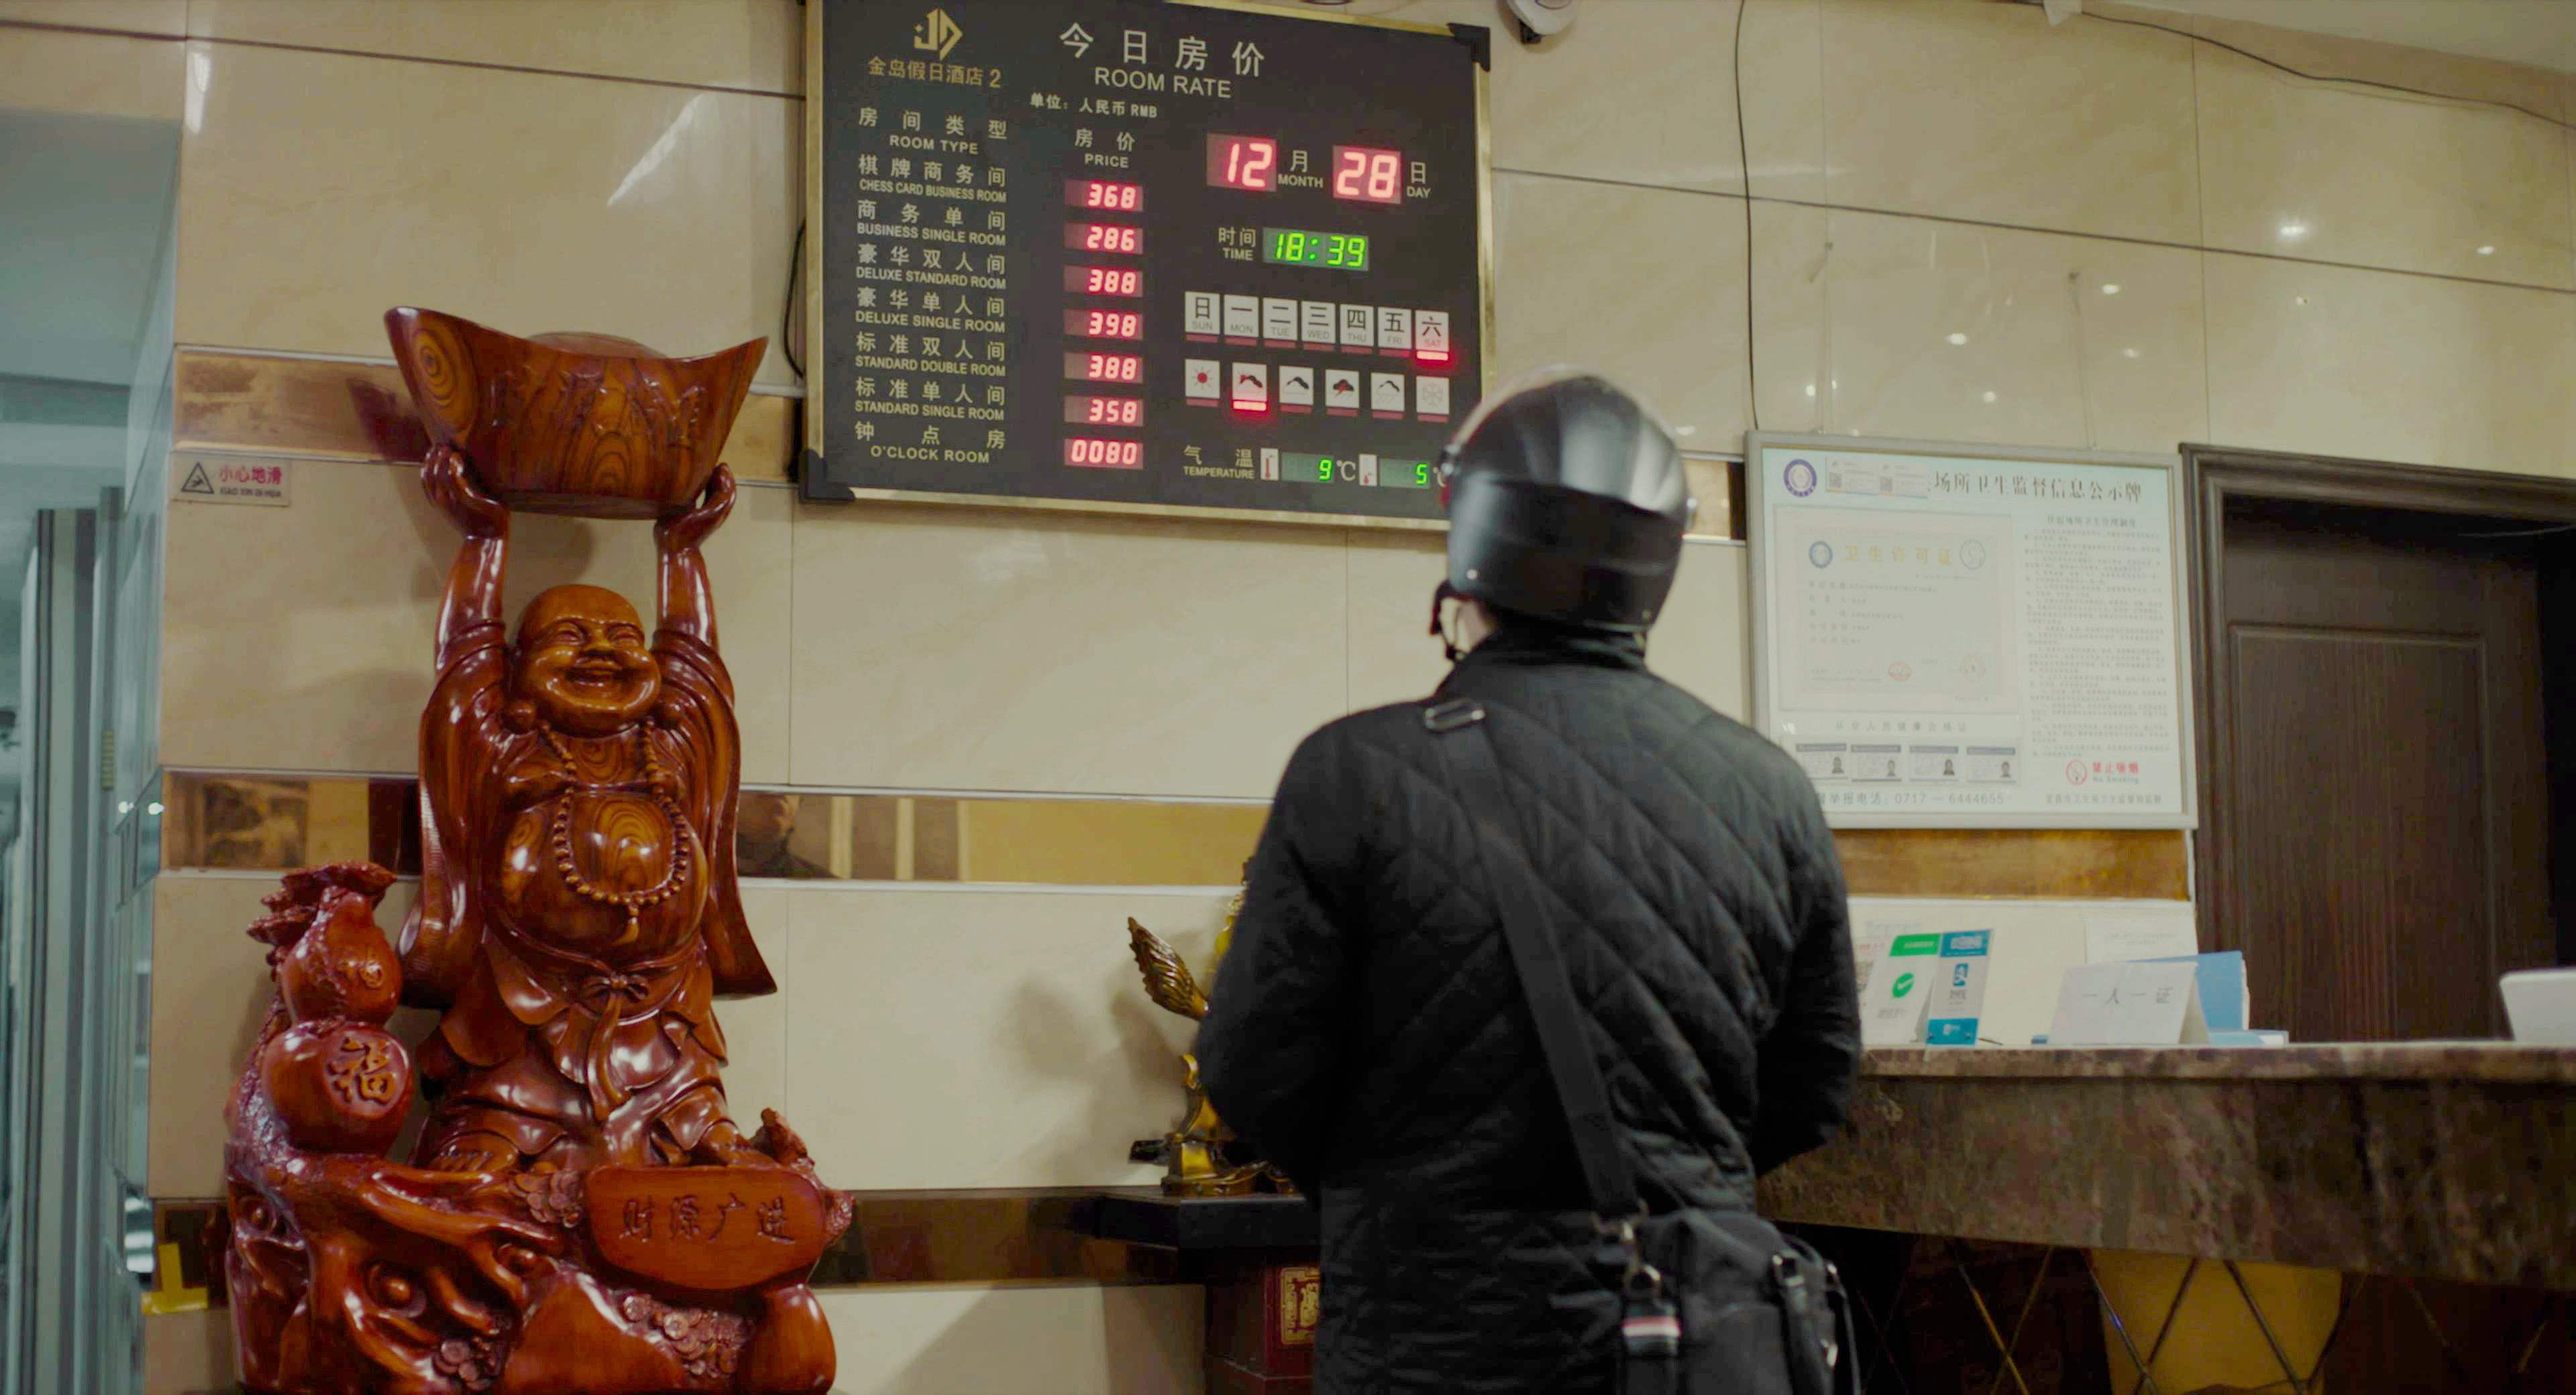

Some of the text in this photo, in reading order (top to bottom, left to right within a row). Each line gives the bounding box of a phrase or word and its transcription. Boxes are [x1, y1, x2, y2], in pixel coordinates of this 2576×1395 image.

[1059, 22, 1265, 77] 今日房价
[868, 56, 1002, 88] 金岛假日酒店 2
[1095, 66, 1232, 99] ROOM RATE
[1079, 98, 1126, 116] 人民币
[1130, 103, 1158, 118] RMB
[859, 107, 1007, 140] 房间类型
[890, 134, 978, 155] ROOM TYPE
[1075, 128, 1136, 152] 房价
[859, 154, 1006, 188] 棋牌商务间
[1085, 154, 1129, 168] PRICE
[1227, 142, 1273, 188] 12
[1290, 150, 1307, 172] 月
[1411, 161, 1426, 184] 日
[1278, 173, 1324, 188] MONTH
[1336, 151, 1398, 199] 28
[859, 178, 1007, 203] CHESS CARD BUSINESS ROOM
[1087, 183, 1136, 209] 368
[1406, 186, 1431, 199] DAY
[857, 199, 1006, 231] 商务单间
[857, 222, 1006, 246] BUSINESS SINGLE ROOM
[1087, 225, 1135, 252] 286
[1218, 227, 1256, 247] 时间
[857, 243, 1005, 275] 豪华双人间
[1222, 247, 1254, 262] TIME
[1275, 232, 1366, 268] 18:39
[856, 266, 1006, 290] DELUXE STANDARD ROOM
[1088, 268, 1136, 294] 388
[857, 286, 1004, 317] 豪华单人间
[1195, 297, 1210, 319] 日
[855, 311, 1005, 333] DELUXE SINGLE ROOM
[1089, 311, 1137, 337] 398
[1192, 321, 1213, 330] SUN
[1270, 305, 1291, 324] 二
[1307, 305, 1330, 327] 三
[1347, 309, 1366, 330] 四
[1384, 312, 1405, 333] 五
[1421, 316, 1442, 337] 六
[1230, 325, 1253, 333] MON
[1271, 327, 1291, 336] TUE
[1307, 329, 1330, 339] WED
[1348, 333, 1366, 343] THU
[1387, 336, 1403, 345] FRI
[856, 331, 1005, 362] 标准双人间
[1425, 339, 1442, 347] SAT
[855, 355, 1006, 377] STANDARD DOUBLE ROOM
[1089, 354, 1137, 380] 388
[855, 376, 1005, 406] 标准单人间
[855, 400, 1004, 421] STANDARD SINGLE ROOM
[1089, 398, 1138, 424] 358
[855, 421, 1006, 449] 钟点房
[870, 445, 989, 463] O'CLOCK ROOM
[1071, 439, 1138, 465] 0080
[1183, 445, 1254, 468] 气温
[219, 463, 282, 485] 小心地滑
[1183, 465, 1254, 479] TEMPERATURE
[1318, 458, 1334, 482] 9
[1415, 462, 1429, 486] 5
[1928, 471, 2142, 503] 场所卫生监督信息公示牌
[326, 1038, 397, 1107] 福
[619, 1192, 796, 1245] 财源广进
